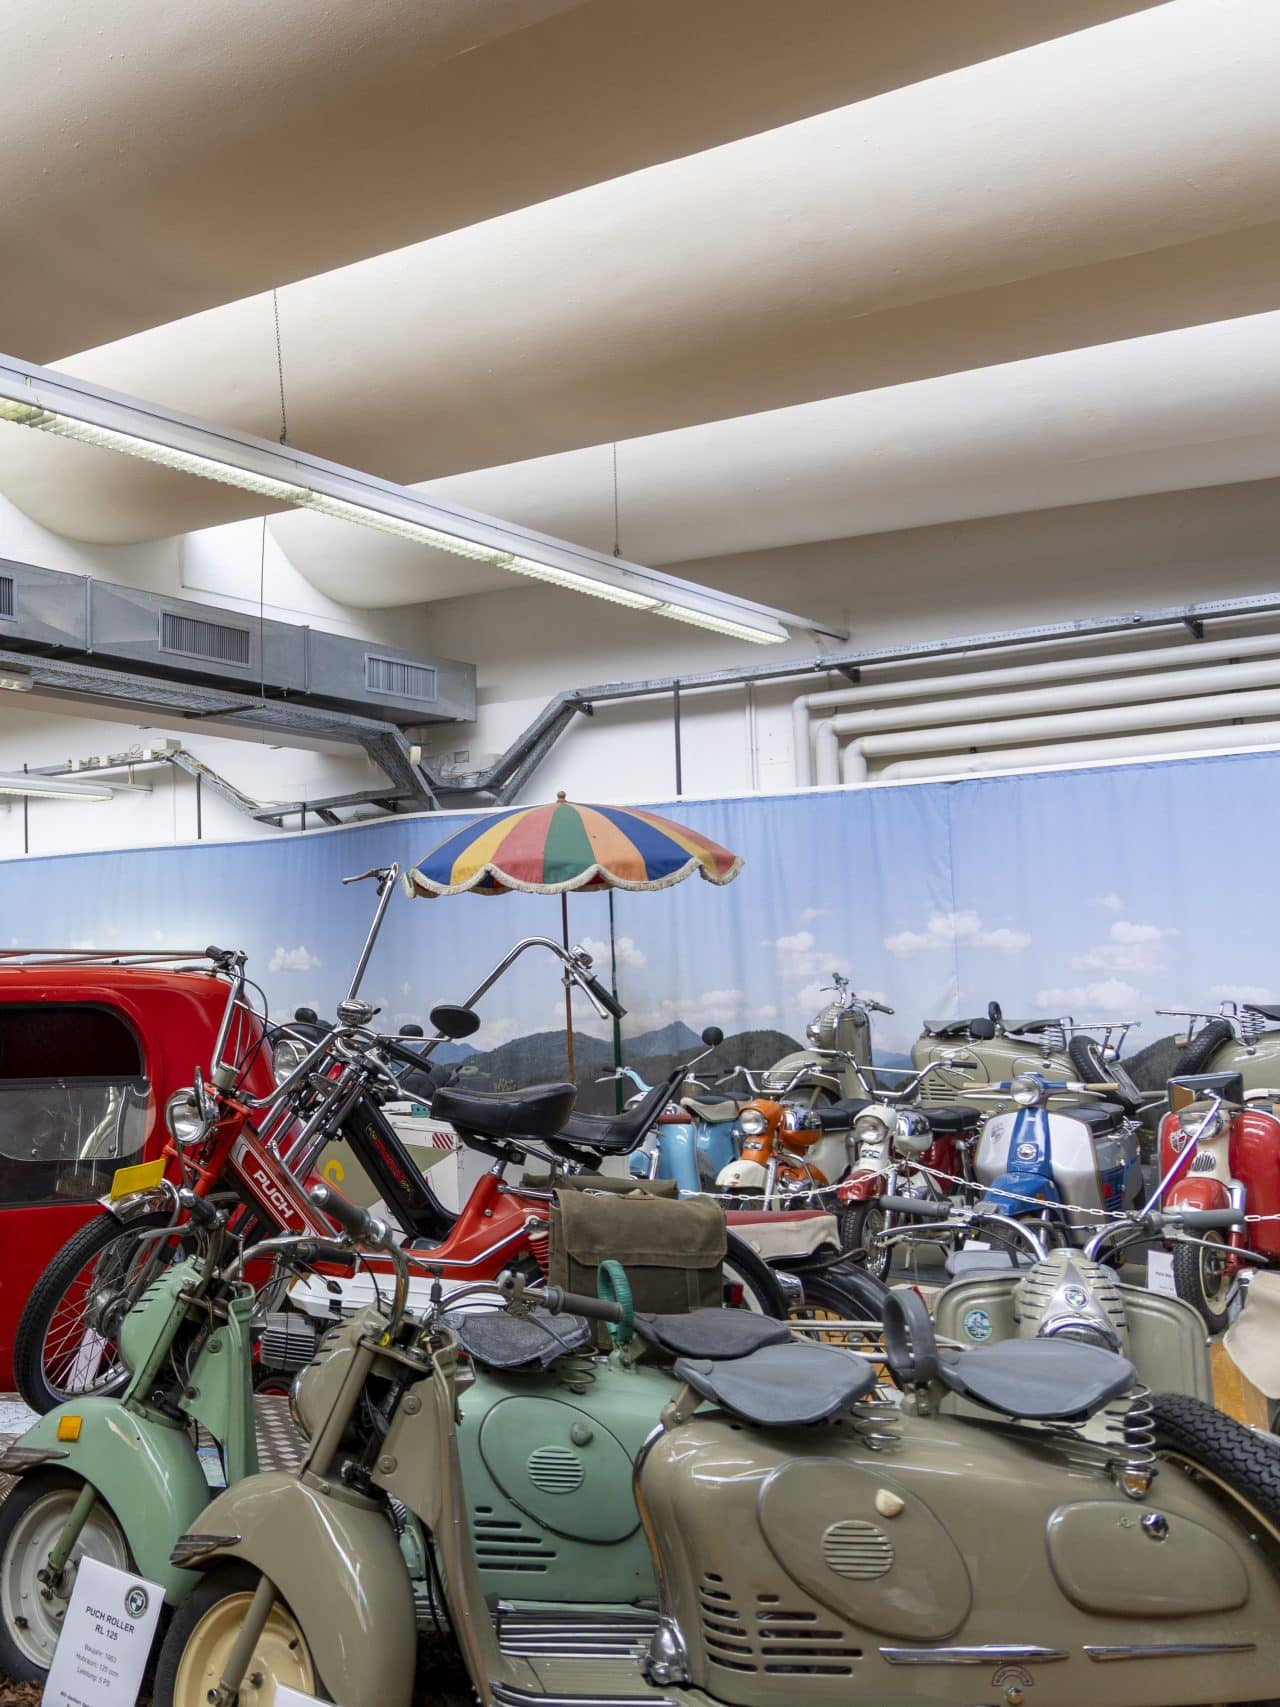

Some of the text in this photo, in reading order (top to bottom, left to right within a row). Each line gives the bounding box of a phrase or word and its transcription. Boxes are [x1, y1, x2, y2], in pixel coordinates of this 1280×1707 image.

[253, 1170, 294, 1218] PUCH
[85, 1606, 135, 1634] PUCH ROLLER
[95, 1624, 119, 1641] RL 125
